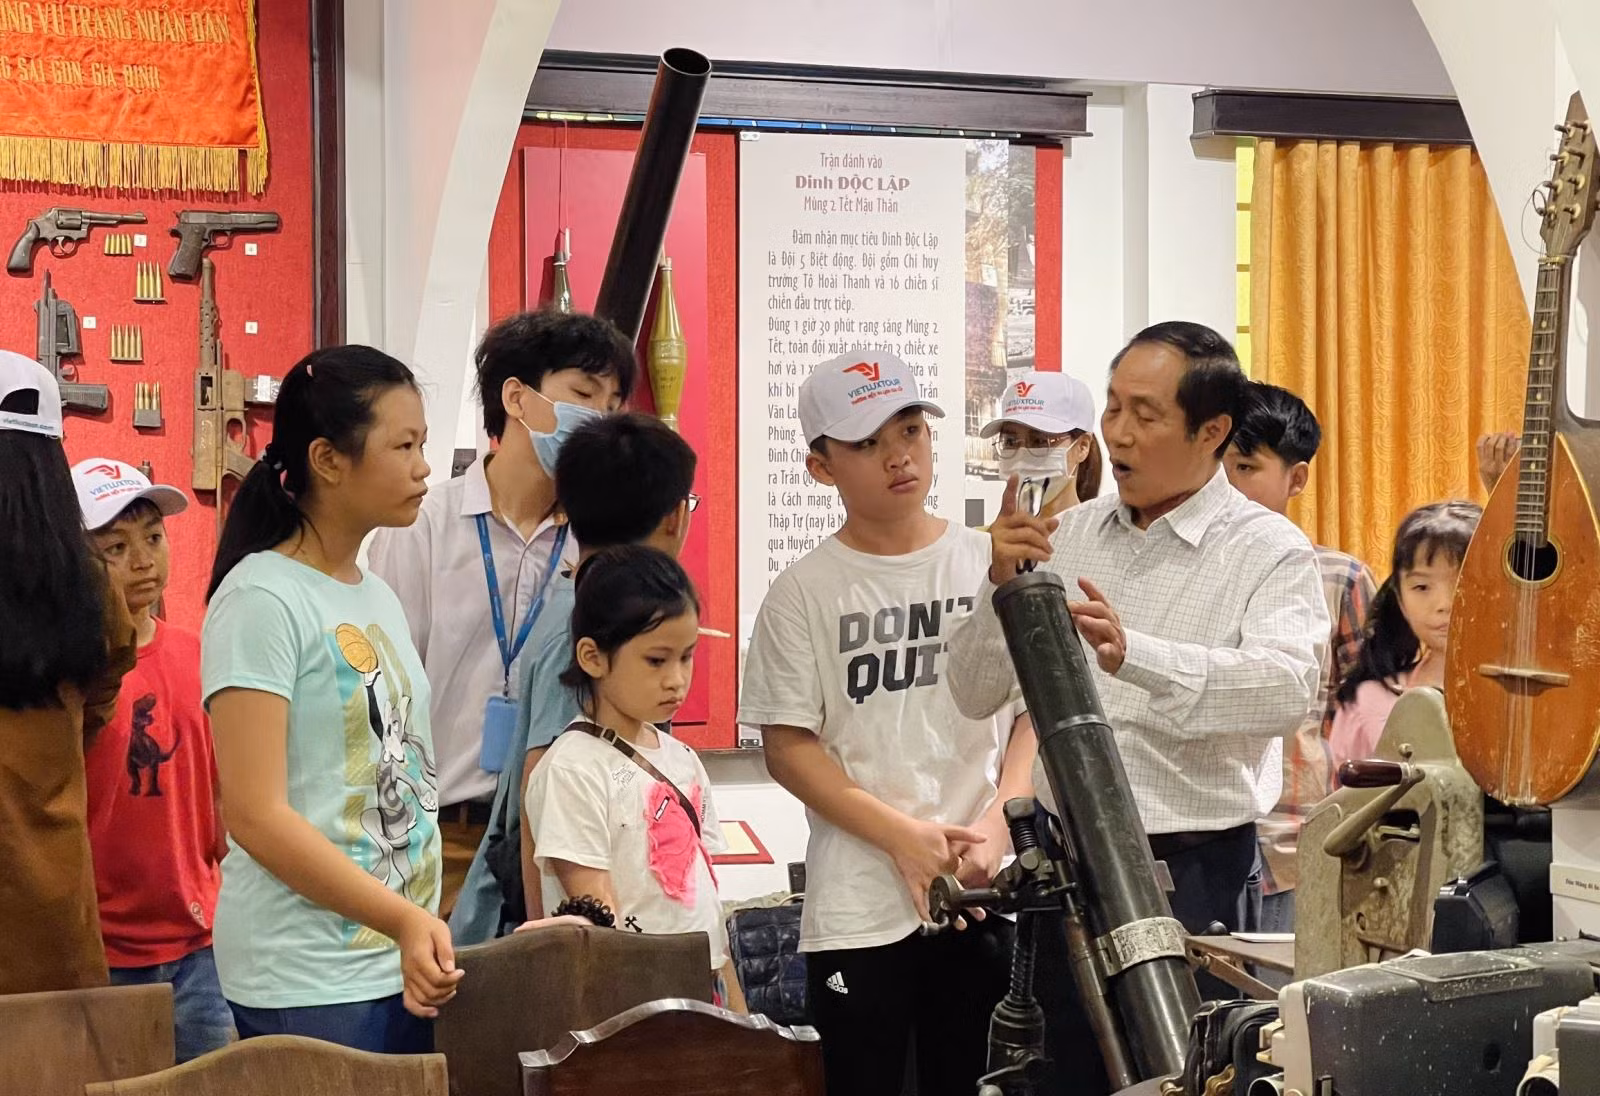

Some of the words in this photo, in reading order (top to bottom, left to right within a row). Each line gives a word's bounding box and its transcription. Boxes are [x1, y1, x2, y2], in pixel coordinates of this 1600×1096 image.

[830, 201, 836, 212] 2
[922, 253, 939, 271] huy
[842, 274, 870, 289] Thanh
[933, 322, 939, 333] 2
[928, 345, 939, 355] xe
[786, 360, 797, 375] và
[908, 362, 924, 376] hứa
[768, 473, 777, 485] ra
[768, 491, 776, 506] là
[768, 538, 784, 554] qua
[847, 641, 949, 705] QUI
